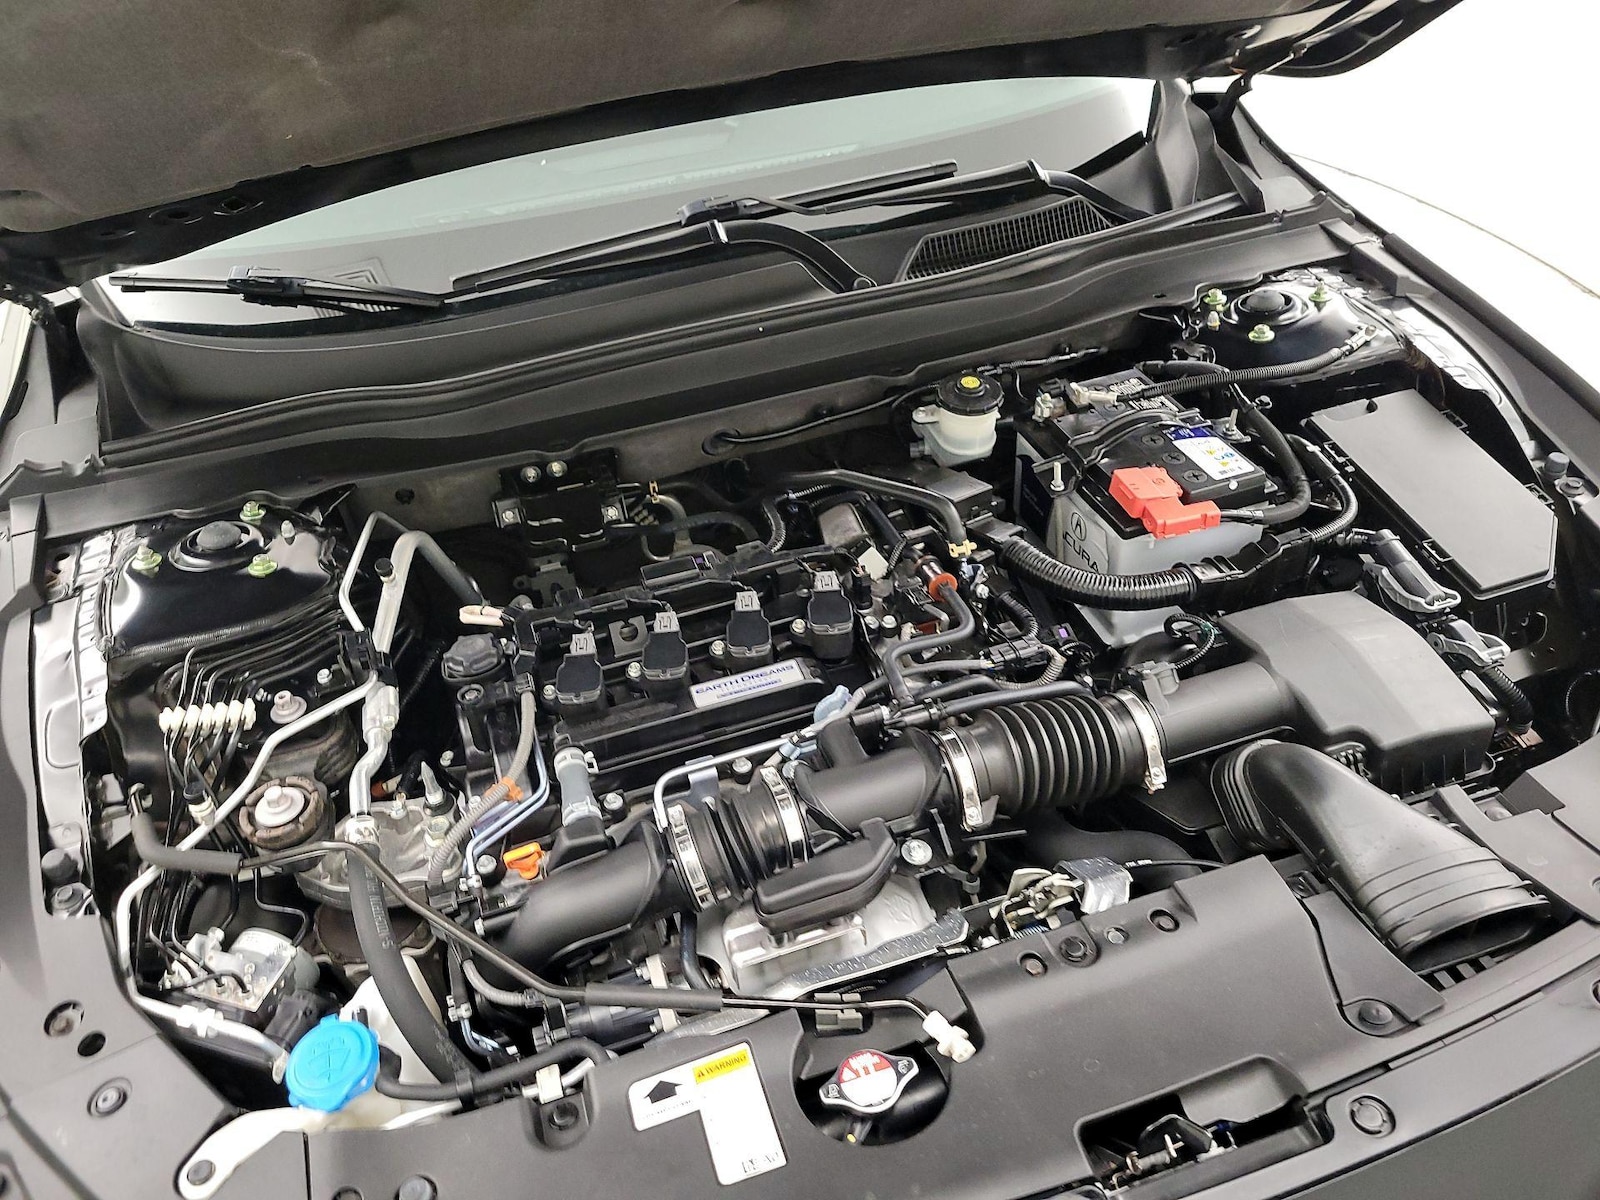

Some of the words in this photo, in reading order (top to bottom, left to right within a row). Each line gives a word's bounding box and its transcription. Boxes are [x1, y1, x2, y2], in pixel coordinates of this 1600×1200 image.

[1062, 531, 1100, 575] CURA
[695, 677, 740, 694] EARTH
[740, 665, 794, 682] DREAMS
[705, 1055, 747, 1074] WARNING
